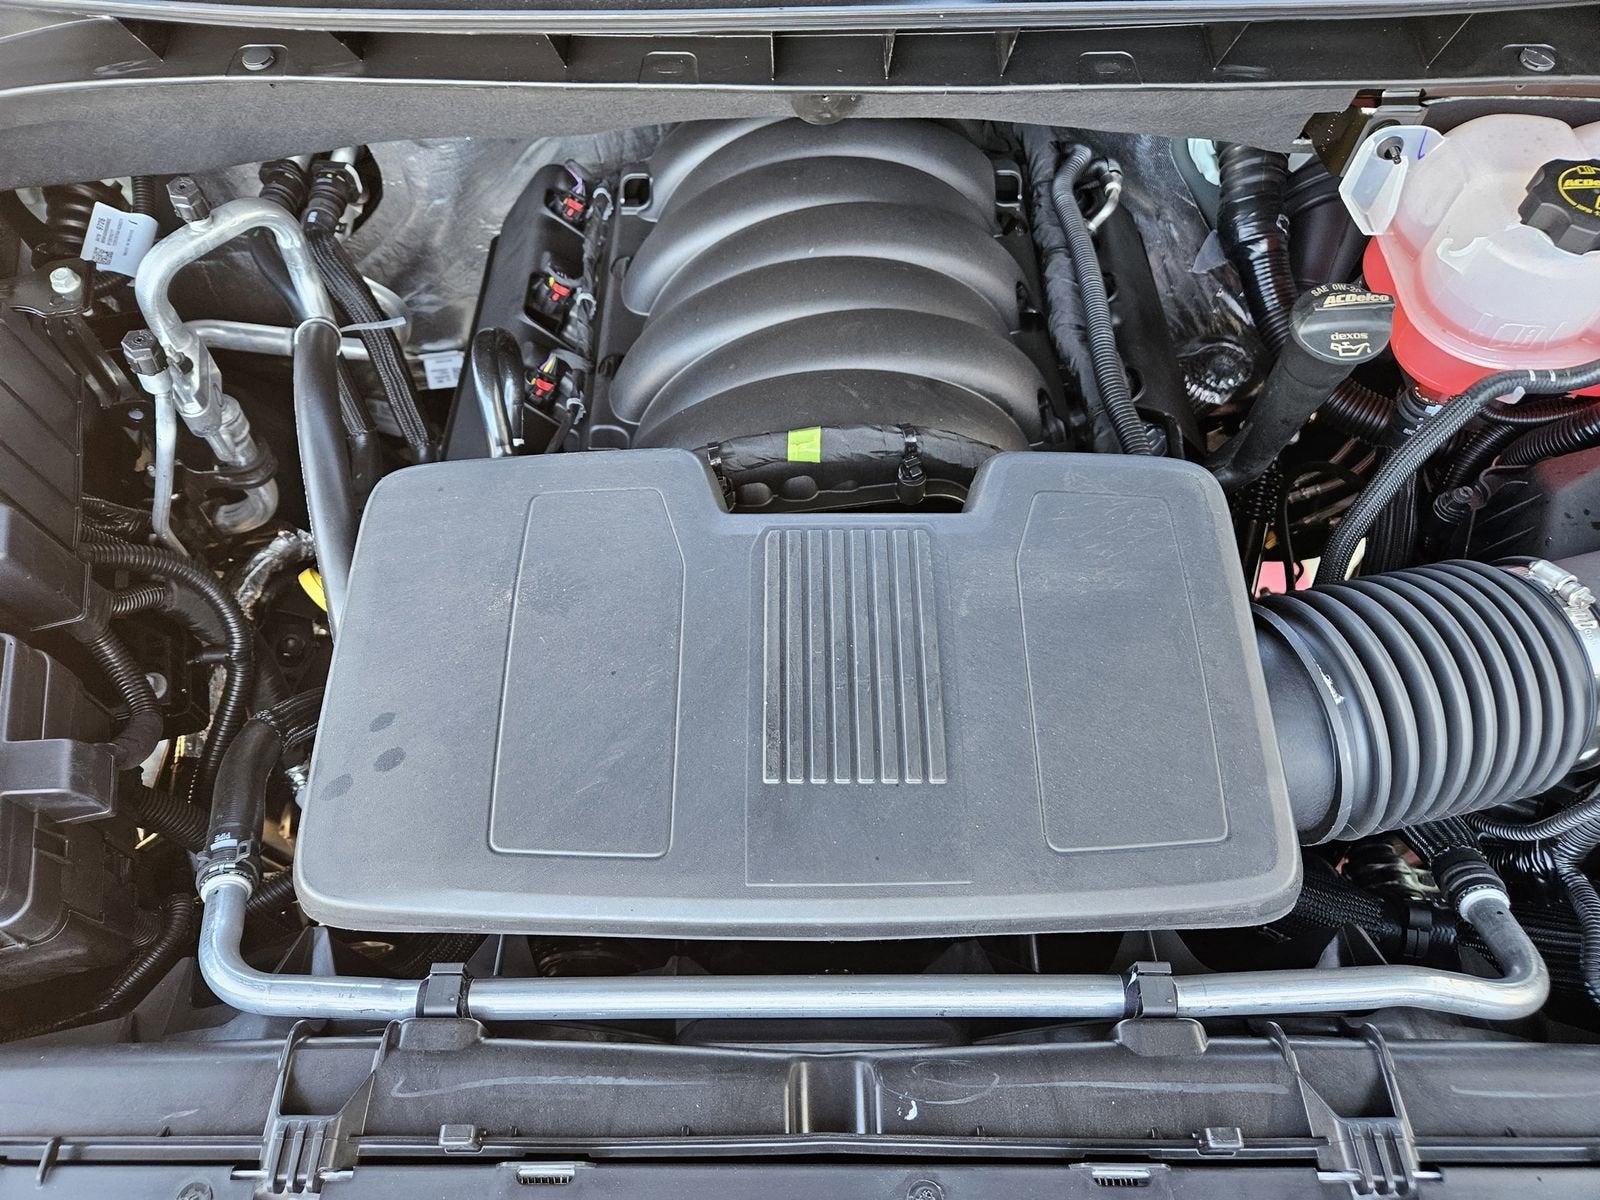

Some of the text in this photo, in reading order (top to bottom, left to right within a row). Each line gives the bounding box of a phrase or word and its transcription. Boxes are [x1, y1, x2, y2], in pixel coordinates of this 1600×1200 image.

[1311, 284, 1330, 297] SAE
[1323, 293, 1389, 305] ACDelco
[1330, 332, 1368, 341] dexos
